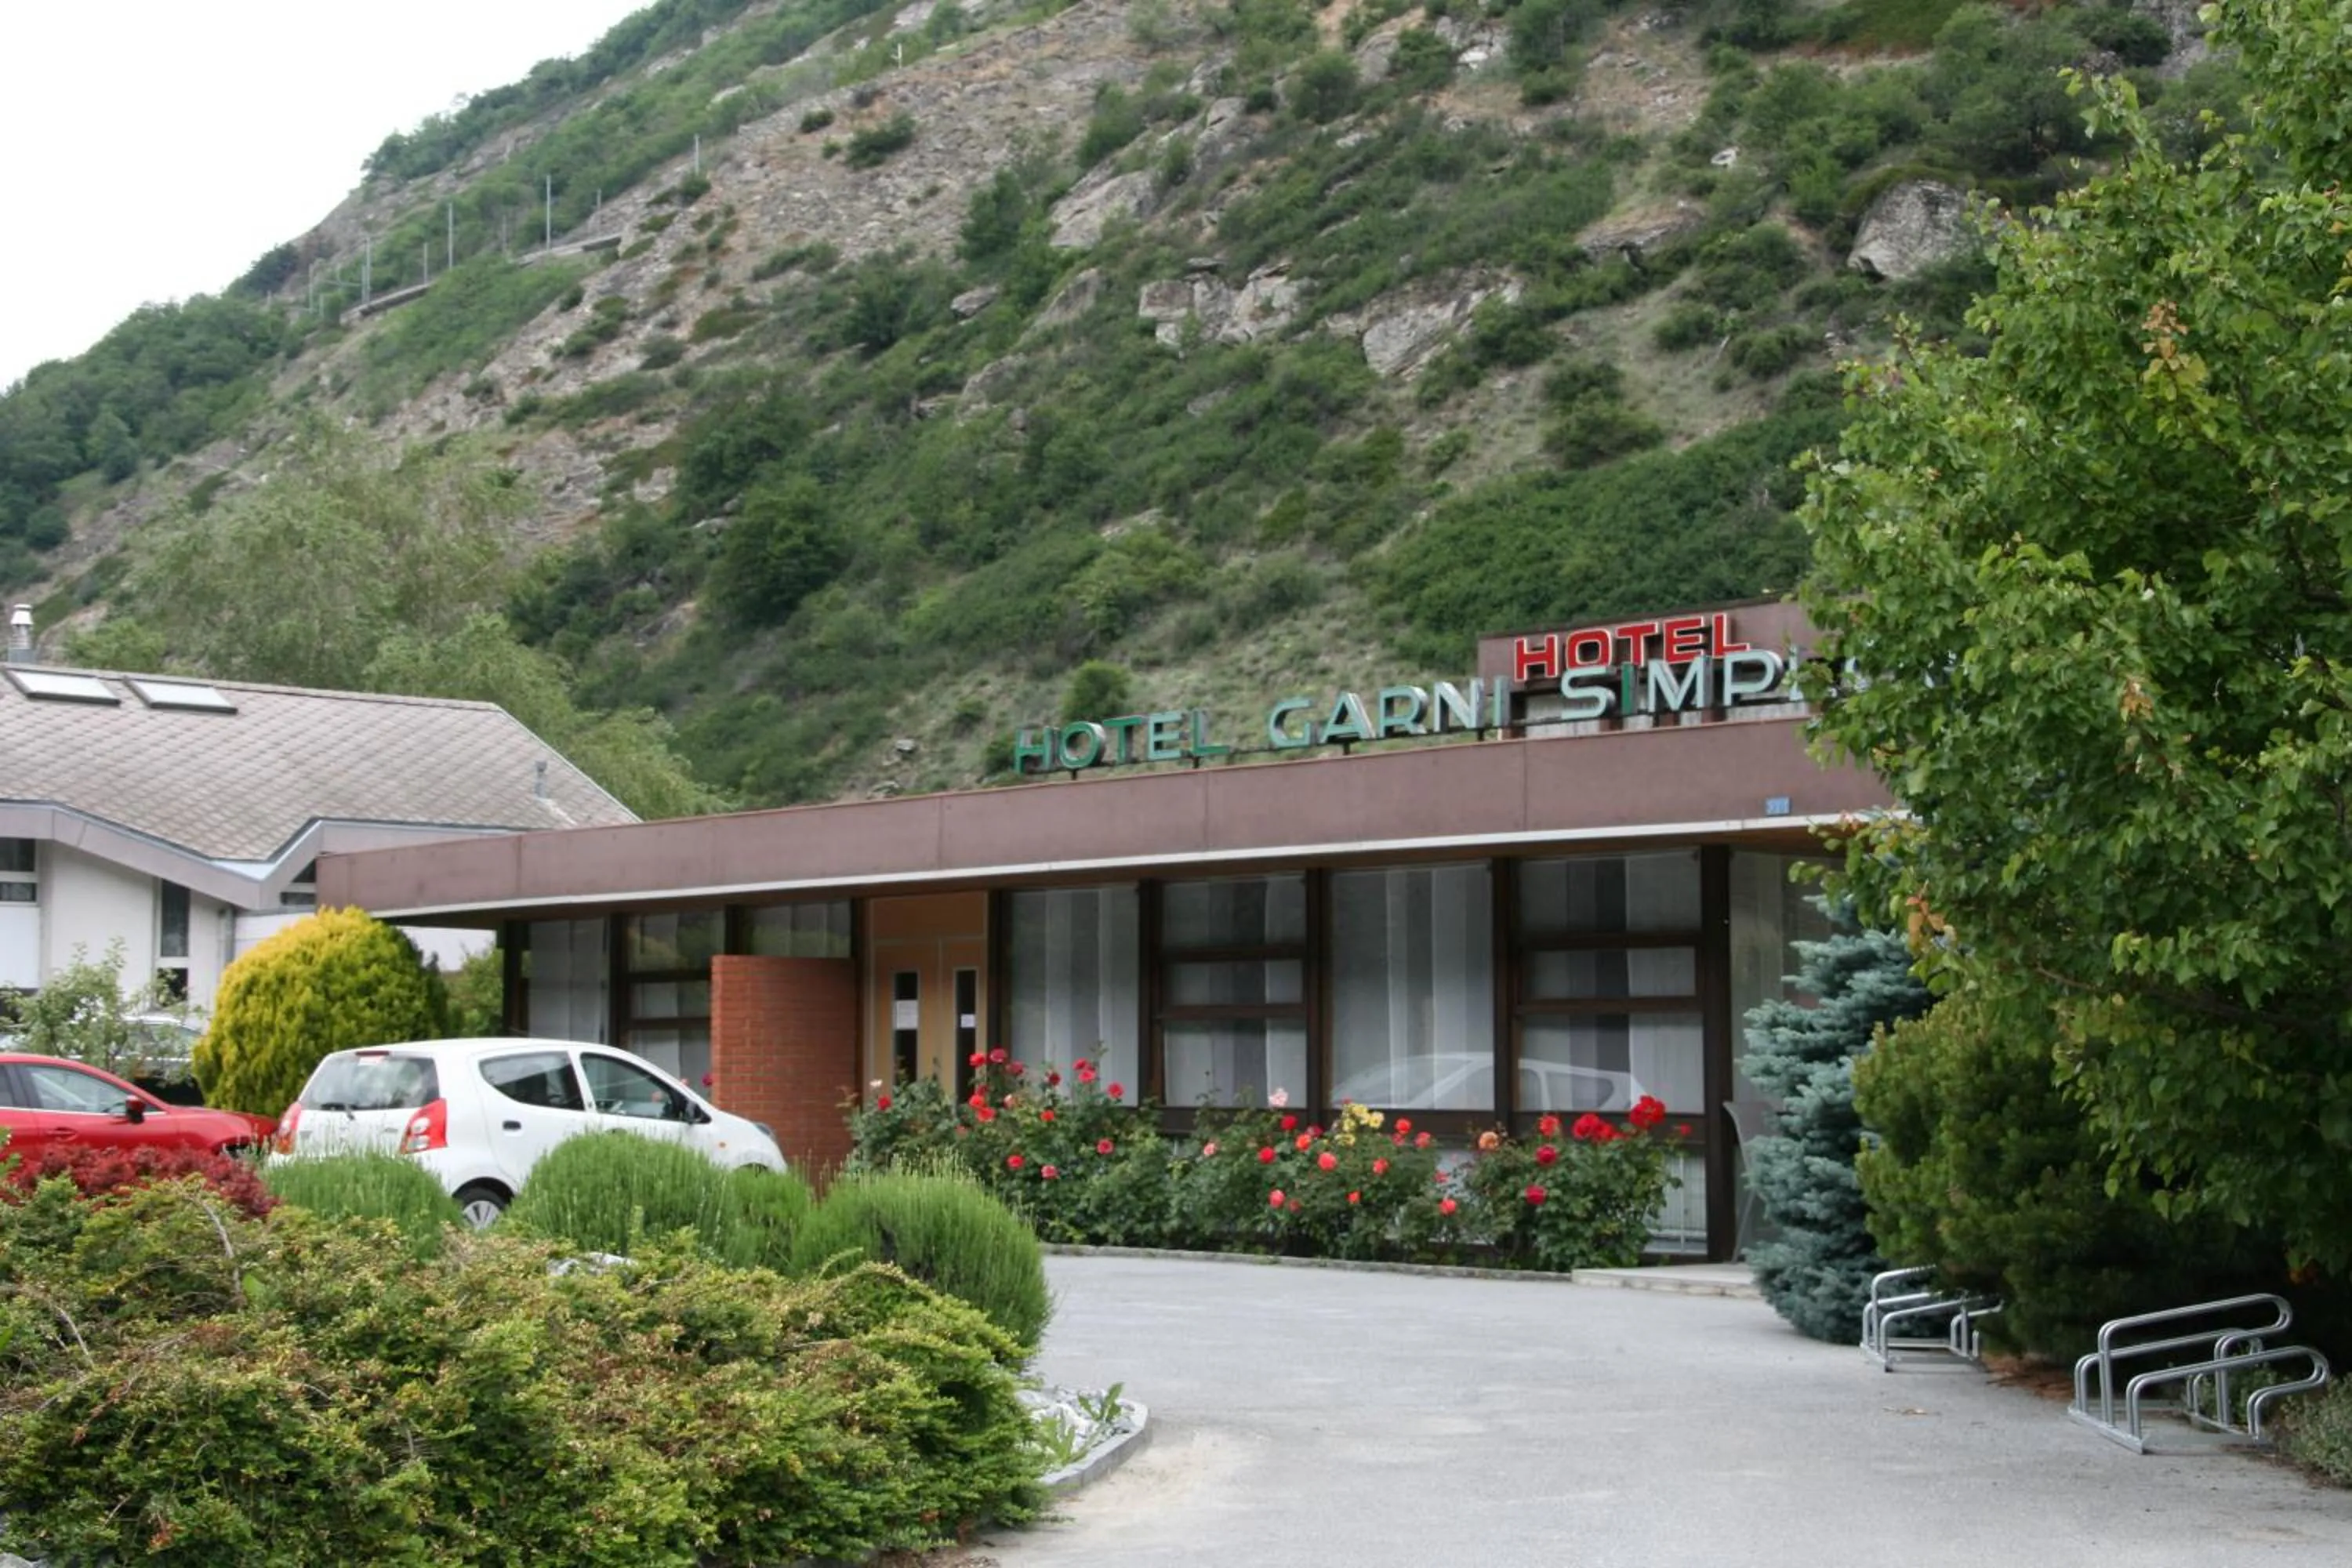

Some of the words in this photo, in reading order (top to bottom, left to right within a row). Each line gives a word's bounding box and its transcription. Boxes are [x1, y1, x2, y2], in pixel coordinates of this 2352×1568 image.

[1514, 614, 1750, 682] HOTEL
[1014, 709, 1229, 775] HOTEL
[1268, 676, 1511, 748] GARNI
[1560, 641, 1874, 720] SIMPL
